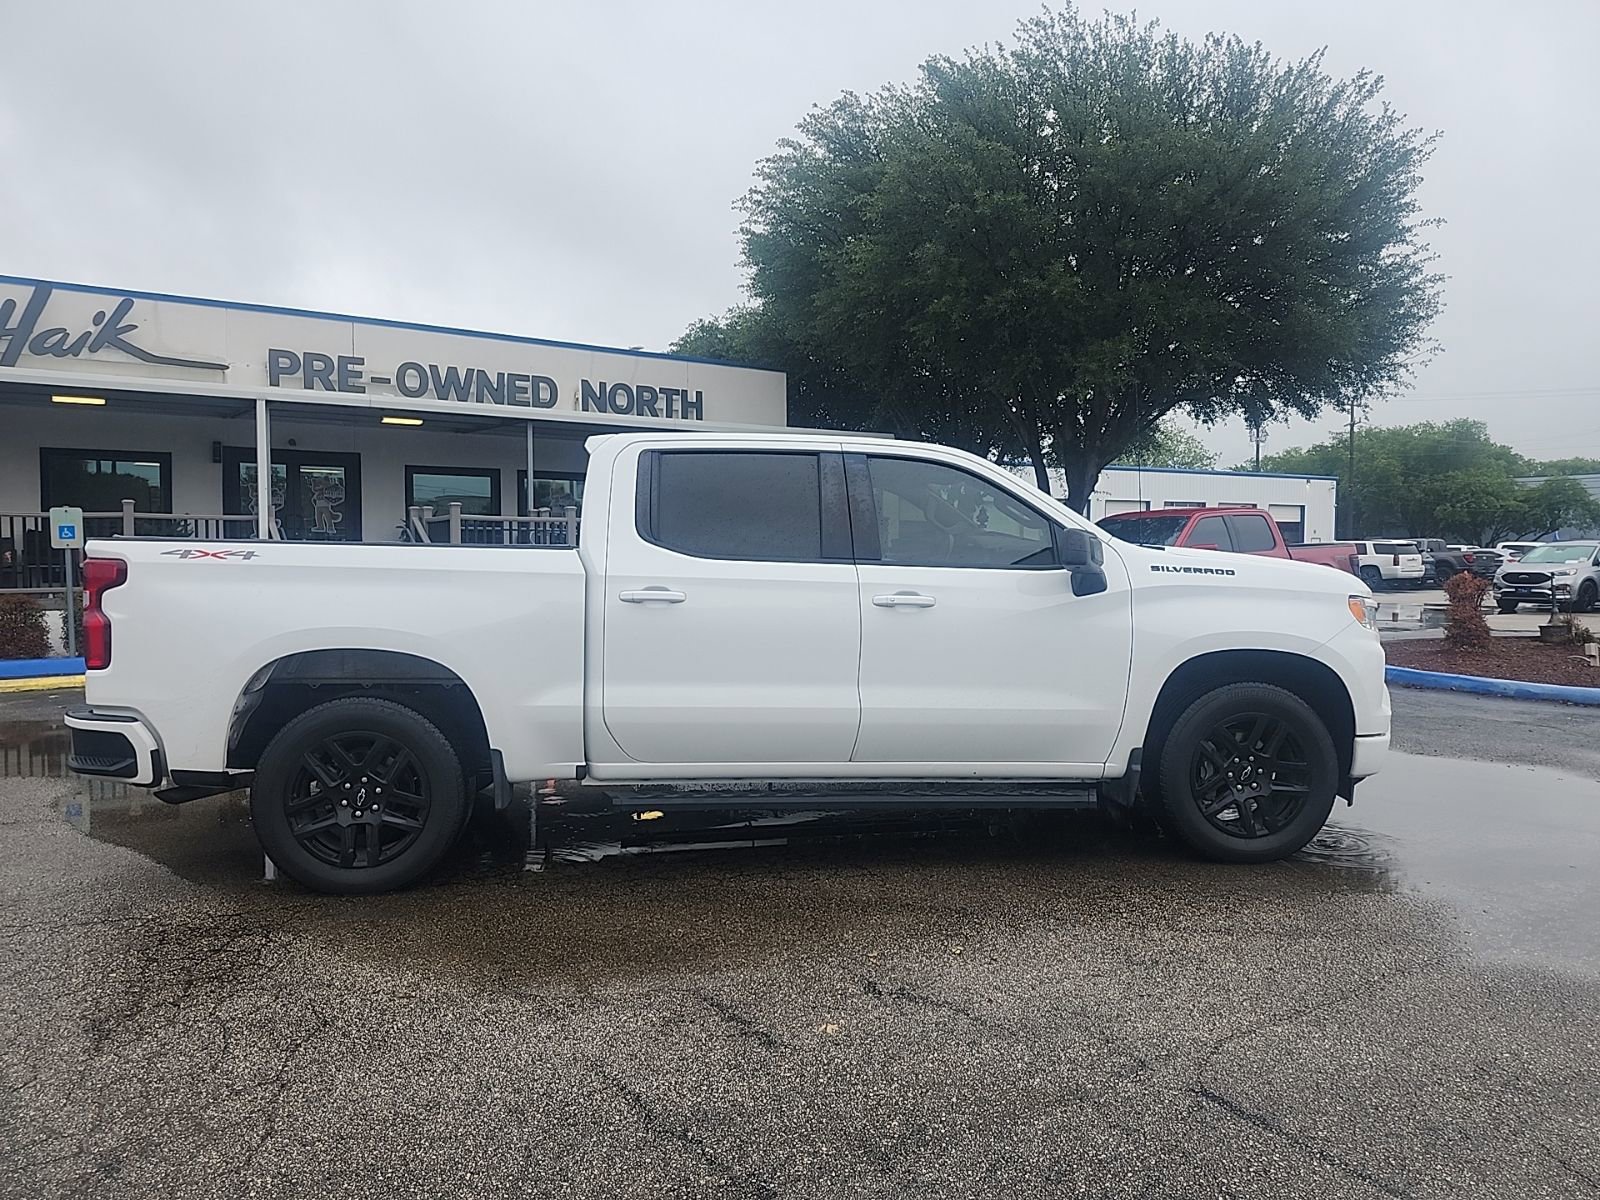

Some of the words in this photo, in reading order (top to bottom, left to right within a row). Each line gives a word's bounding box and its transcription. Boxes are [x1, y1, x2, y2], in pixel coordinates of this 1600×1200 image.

[0, 284, 229, 368] Haik
[267, 348, 559, 408] PRE-OWNED
[580, 379, 704, 420] NORTH
[1150, 565, 1236, 576] SILVERADO
